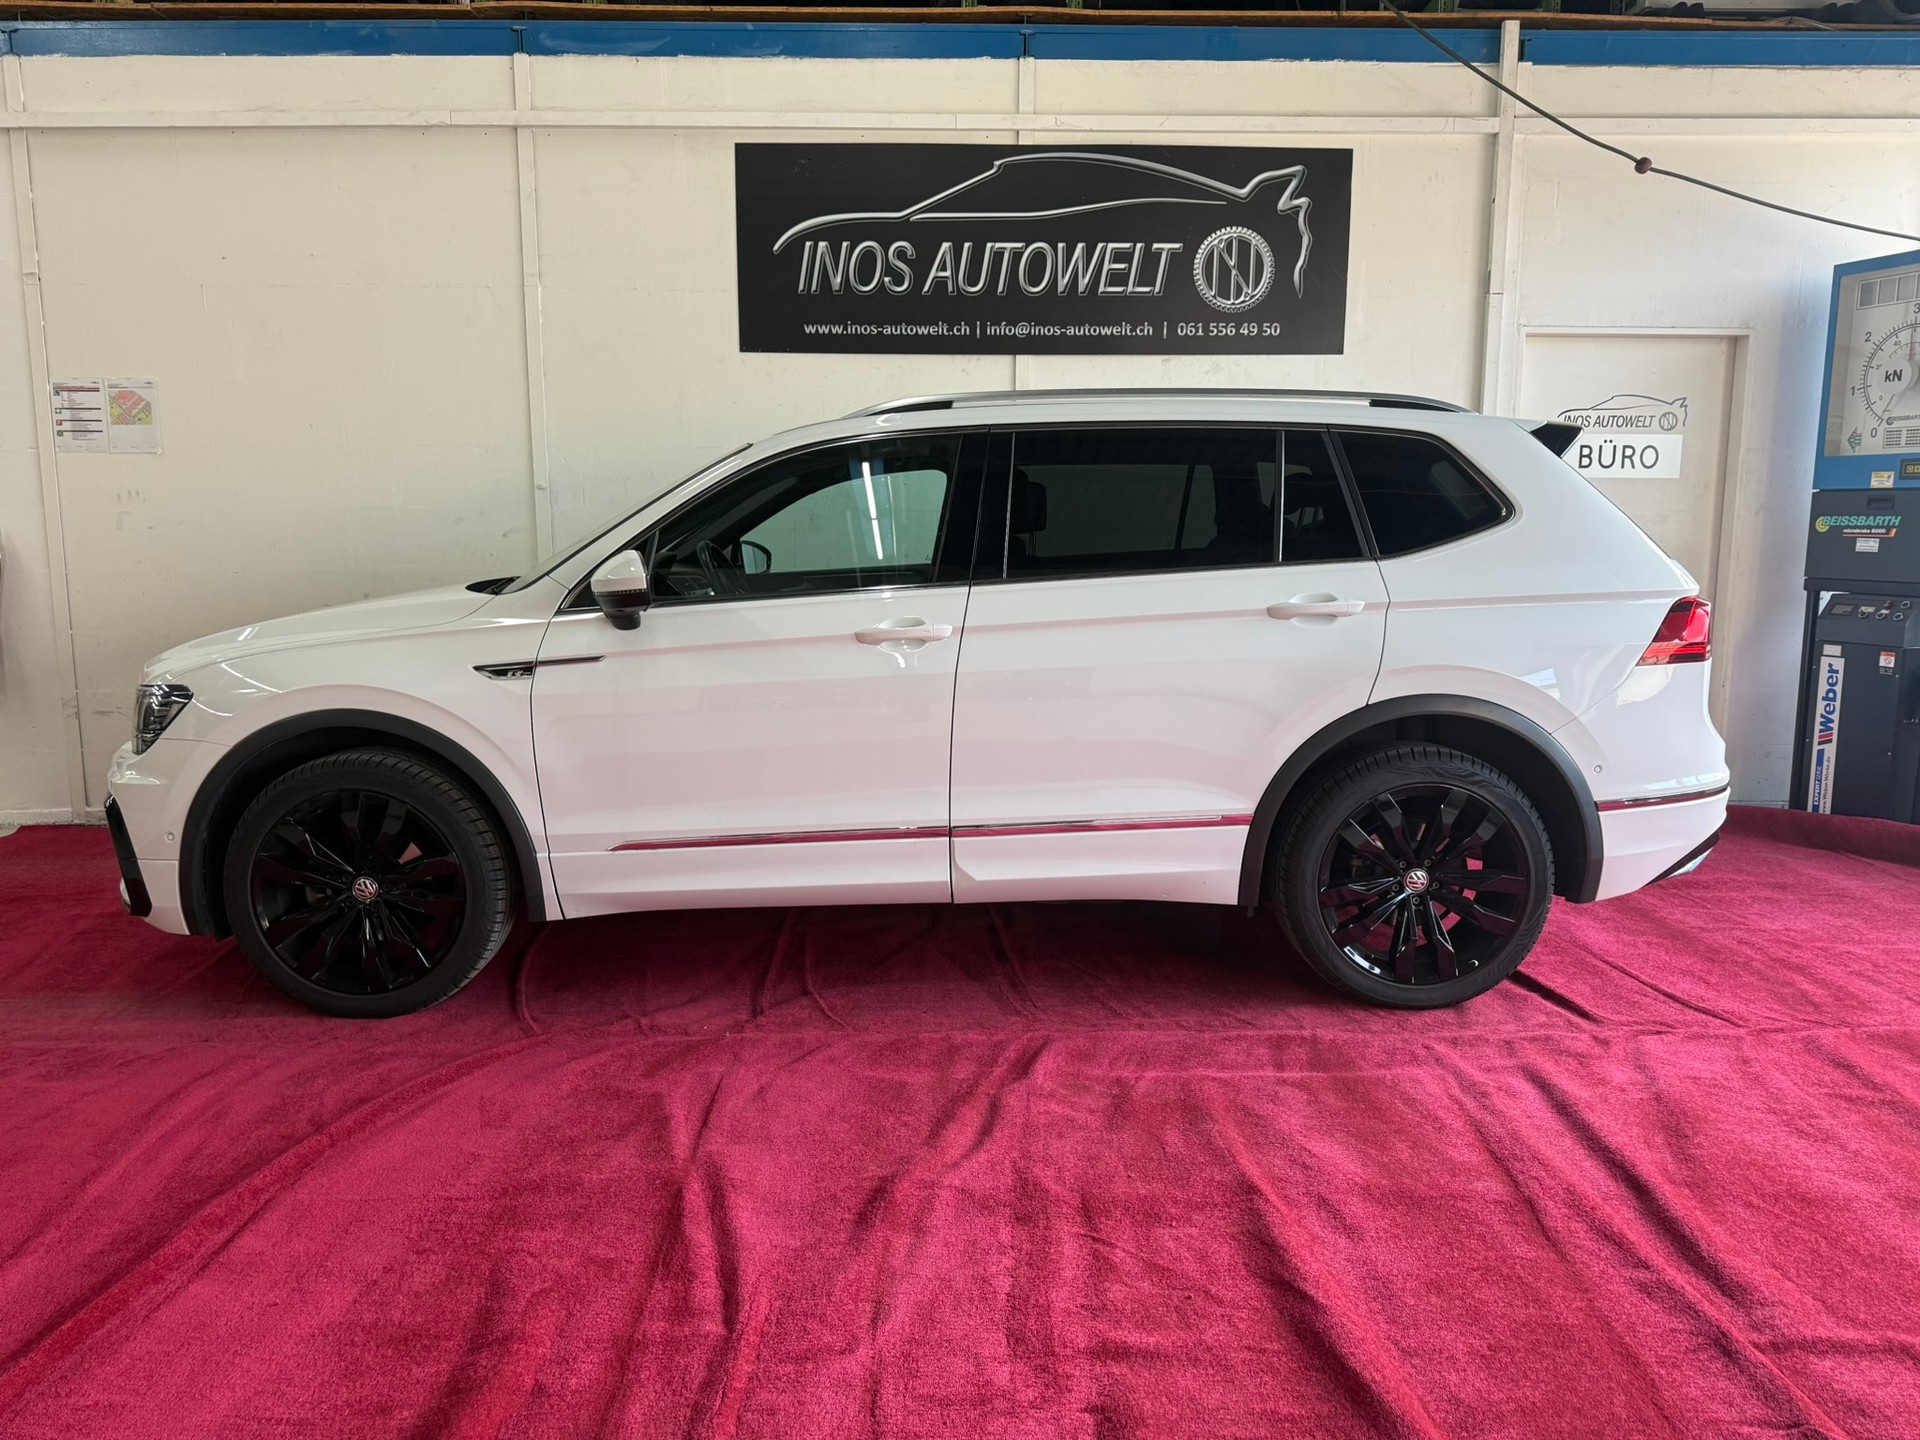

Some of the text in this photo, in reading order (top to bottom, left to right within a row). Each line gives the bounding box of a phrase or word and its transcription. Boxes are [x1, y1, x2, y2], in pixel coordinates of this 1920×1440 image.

[798, 240, 1184, 297] INOS AUTOWELT
[1913, 302, 1920, 314] 3
[803, 320, 970, 337] www.inos-autowelt.ch
[986, 321, 1153, 338] info@inos-autowelt.ch
[1177, 322, 1205, 337] 061
[1208, 322, 1236, 337] 556
[1239, 322, 1259, 337] 49
[1261, 322, 1281, 337] 50
[1864, 331, 1872, 343] 2
[1884, 369, 1903, 382] kN
[1850, 386, 1856, 396] 1
[1592, 415, 1656, 428] AUTOWELT
[1870, 427, 1878, 438] 0
[1578, 439, 1659, 469] BÜRO
[1822, 515, 1901, 528] BEISSBARTH
[1819, 662, 1840, 734] Weber
[1813, 780, 1821, 805] EXPERT
